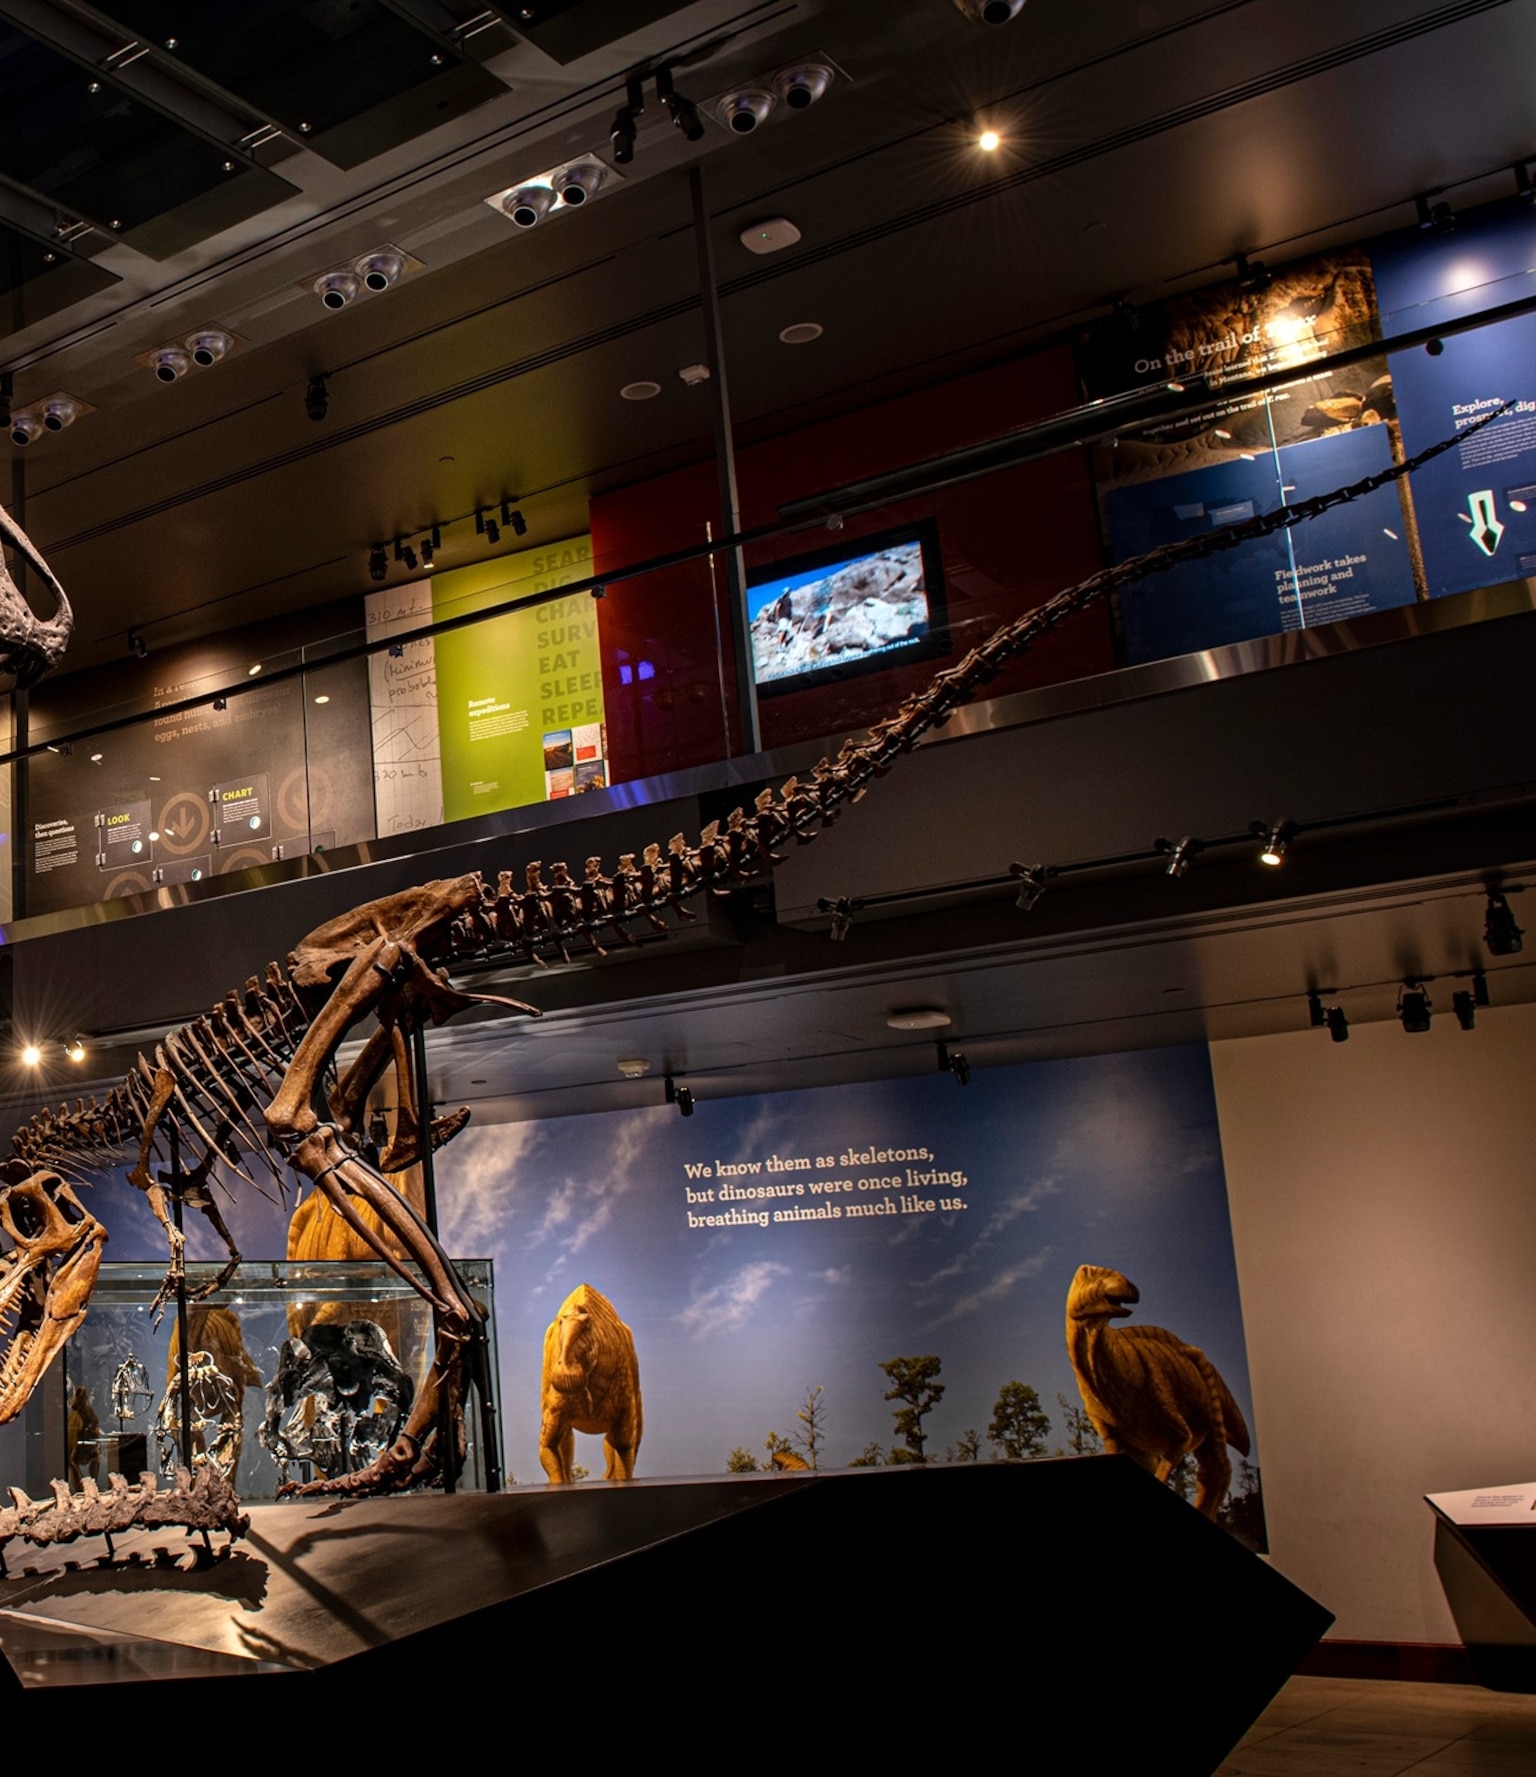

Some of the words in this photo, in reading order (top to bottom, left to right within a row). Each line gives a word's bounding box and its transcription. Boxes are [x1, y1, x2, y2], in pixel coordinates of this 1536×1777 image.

[1134, 358, 1162, 374] On
[1164, 348, 1195, 366] the
[1198, 331, 1239, 357] trail
[1241, 325, 1261, 345] of
[1452, 397, 1505, 416] Explore,
[1454, 407, 1514, 430] prospt,
[1515, 400, 1536, 413] dig
[1274, 559, 1333, 581] Fiedwork
[1334, 554, 1367, 567] takes
[1330, 568, 1354, 582] and
[538, 649, 581, 676] EAT
[542, 698, 603, 727] REPE
[153, 728, 181, 743] eggs,
[181, 719, 211, 736] nests,
[212, 714, 232, 728] and
[222, 787, 253, 801] CHART
[107, 813, 131, 826] LOOK
[684, 1163, 713, 1179] We
[715, 1159, 763, 1177] know
[765, 1154, 812, 1173] them
[815, 1154, 835, 1168] as
[839, 1145, 935, 1167] skeletons,
[685, 1187, 715, 1203] but
[718, 1178, 806, 1202] dinosaurs
[808, 1177, 854, 1195] were
[857, 1173, 903, 1190] once
[905, 1168, 969, 1188] living,
[687, 1208, 770, 1228] breathing
[772, 1201, 842, 1222] animals
[845, 1196, 898, 1218] much
[900, 1193, 937, 1214] like
[939, 1196, 969, 1211] us.
